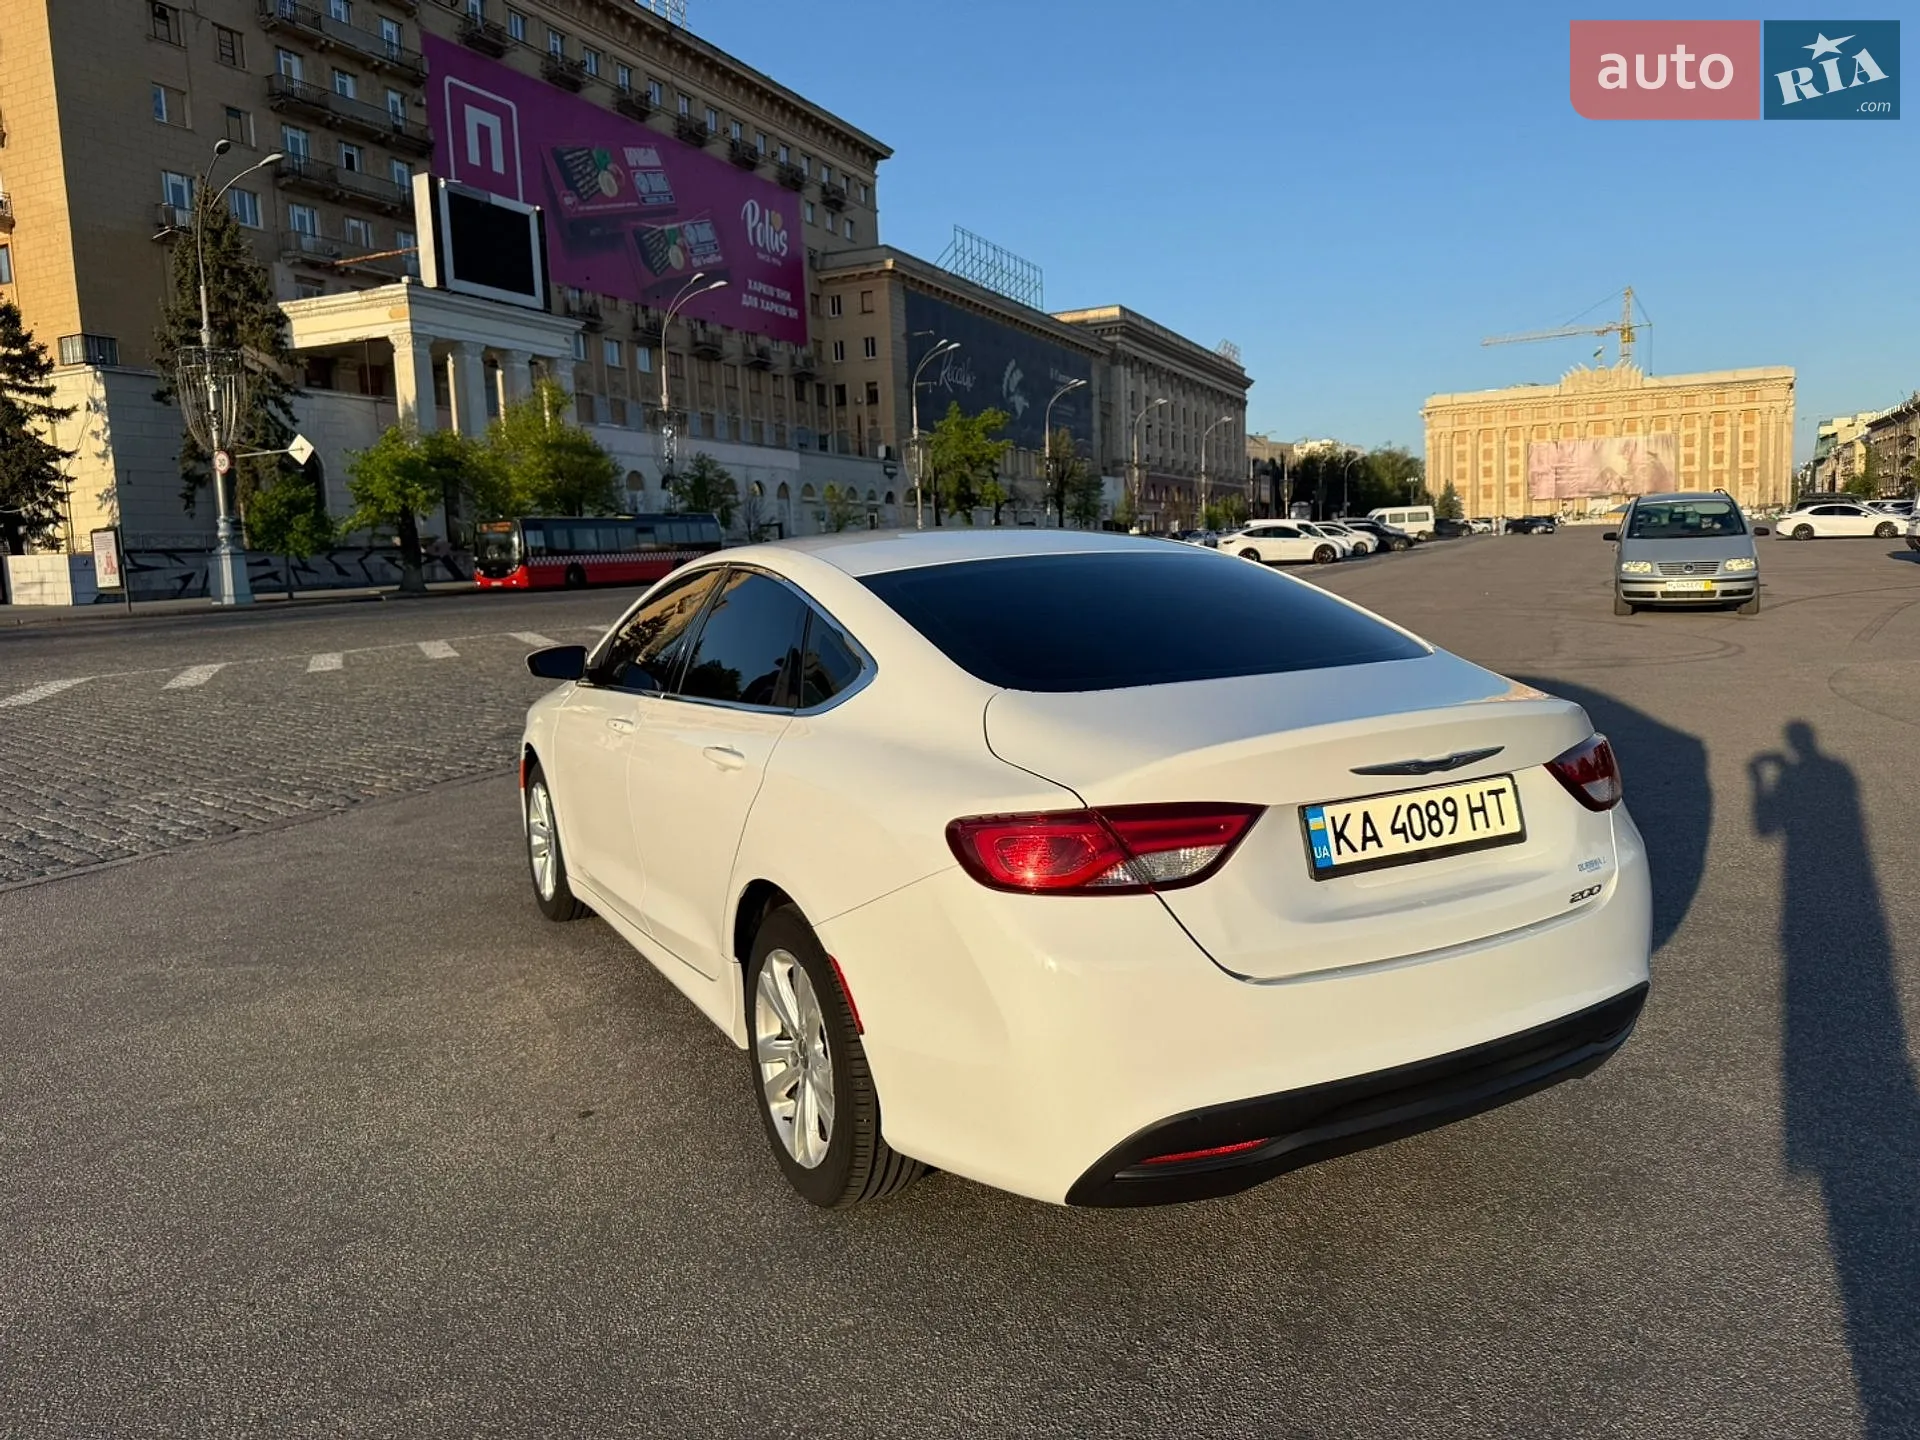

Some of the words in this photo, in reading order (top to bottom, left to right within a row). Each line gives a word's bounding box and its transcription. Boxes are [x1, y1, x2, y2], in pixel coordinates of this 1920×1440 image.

[741, 199, 788, 257] Polus
[1331, 811, 1383, 856] KA
[1390, 797, 1458, 843] 4089
[1466, 788, 1507, 831] HT
[1314, 846, 1331, 859] UA
[1569, 884, 1602, 904] 200
